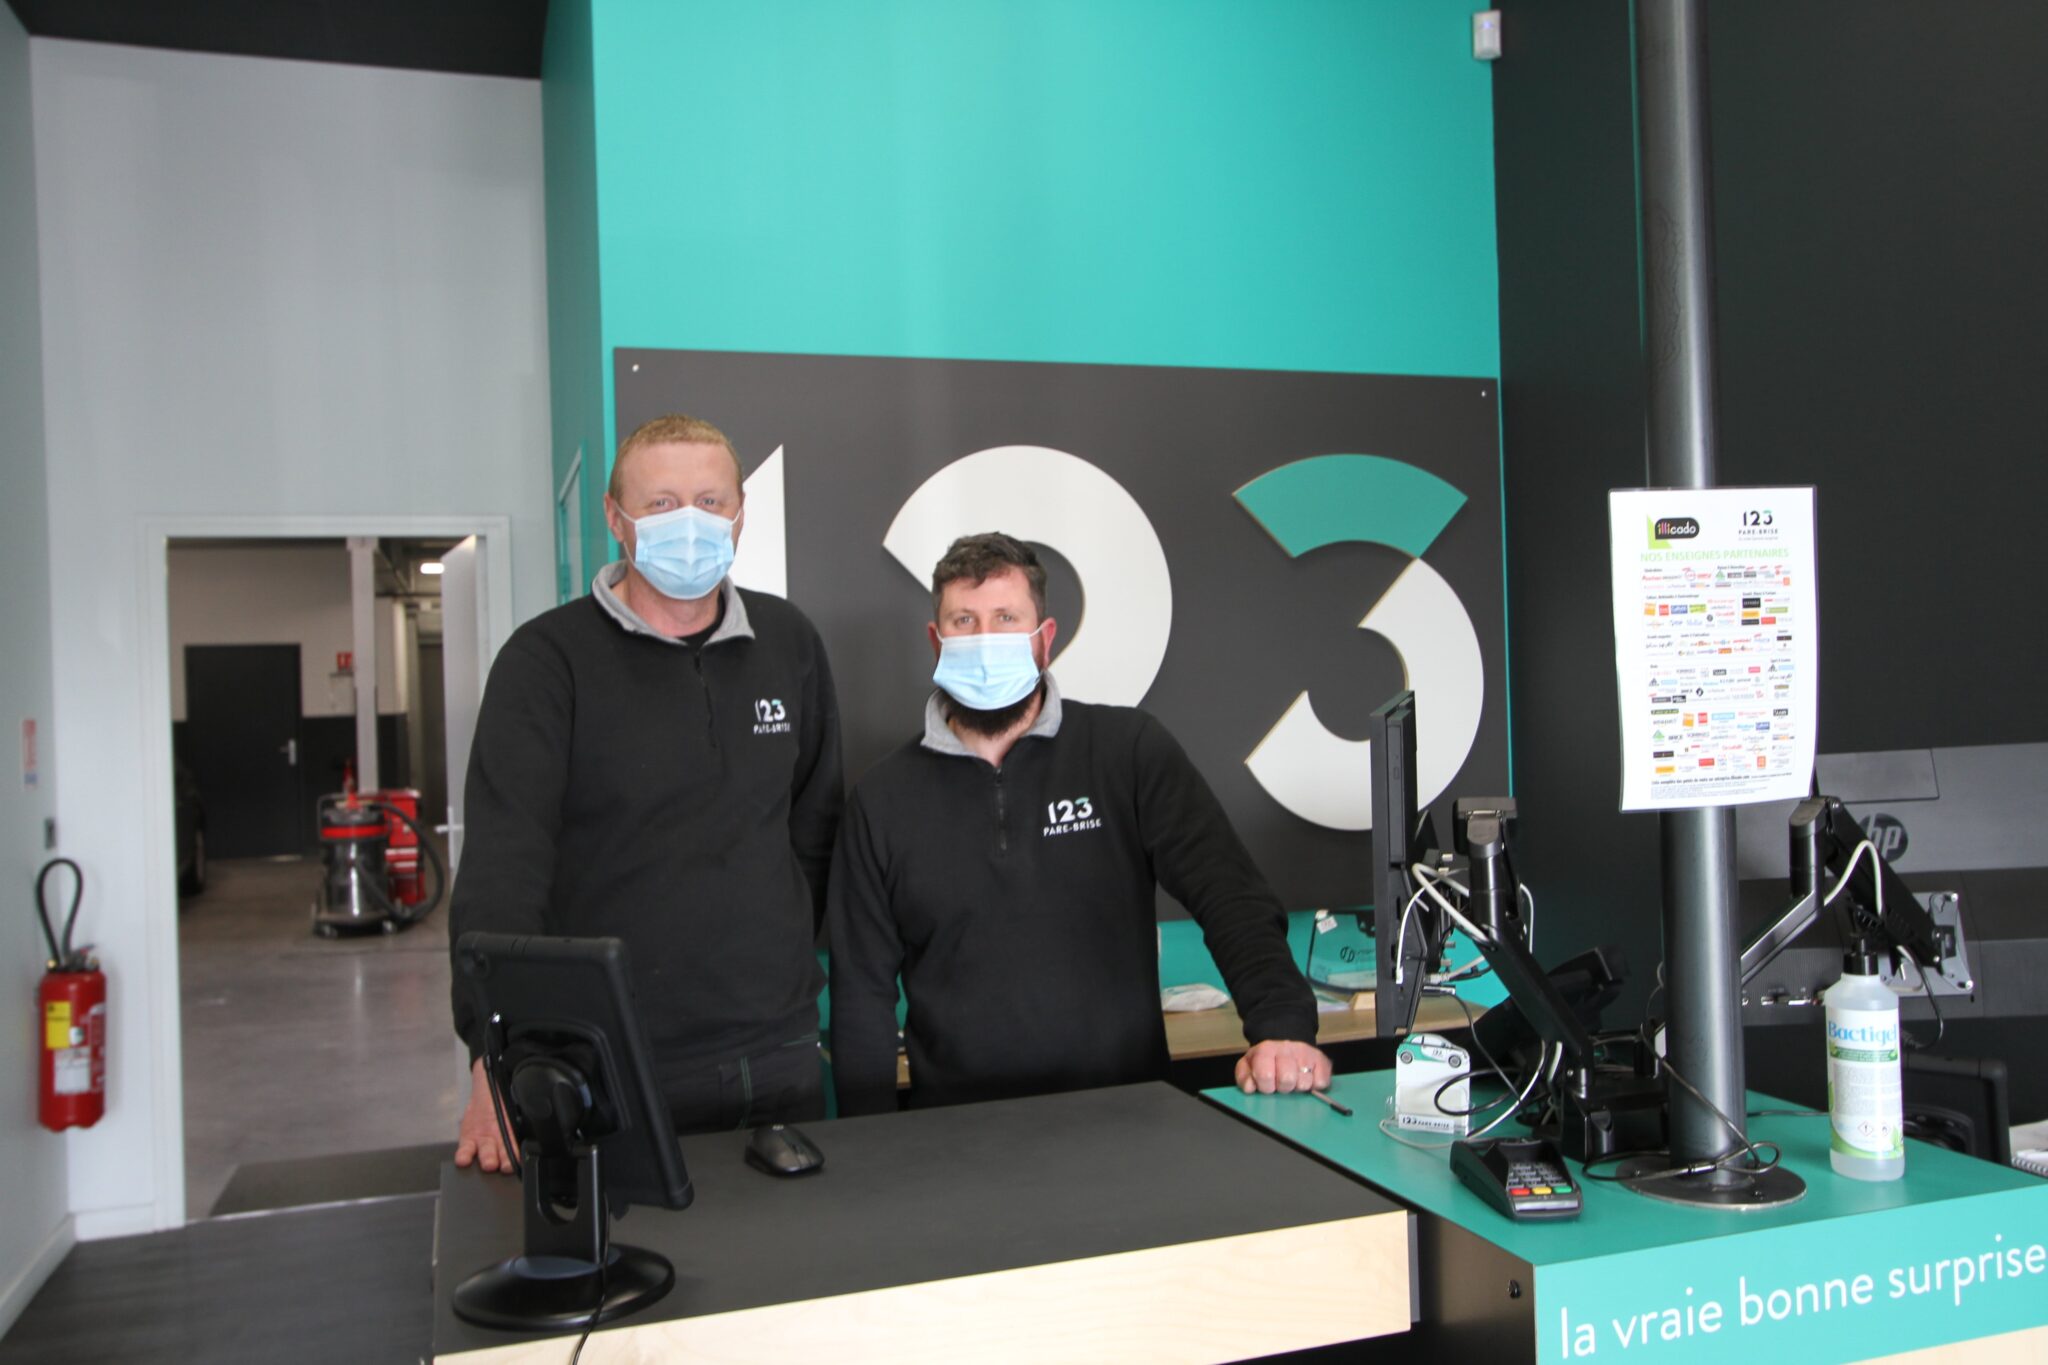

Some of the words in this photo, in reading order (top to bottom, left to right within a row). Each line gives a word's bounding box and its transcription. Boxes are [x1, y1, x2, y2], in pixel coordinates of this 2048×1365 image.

[1657, 521, 1696, 535] illicado
[1742, 510, 1773, 526] 123
[1640, 552, 1663, 562] NOS
[1665, 550, 1721, 561] ENSEIGNES
[1723, 547, 1790, 559] PARTENAIRES
[755, 699, 786, 722] 123
[1048, 797, 1093, 824] 123
[1043, 818, 1102, 837] PARE-BRISE
[1828, 1020, 1898, 1046] Bactigel
[1560, 1306, 1596, 1359] la
[1611, 1286, 1723, 1350] vraie
[1738, 1275, 1874, 1327] bonne
[1887, 1233, 2046, 1307] surprise
